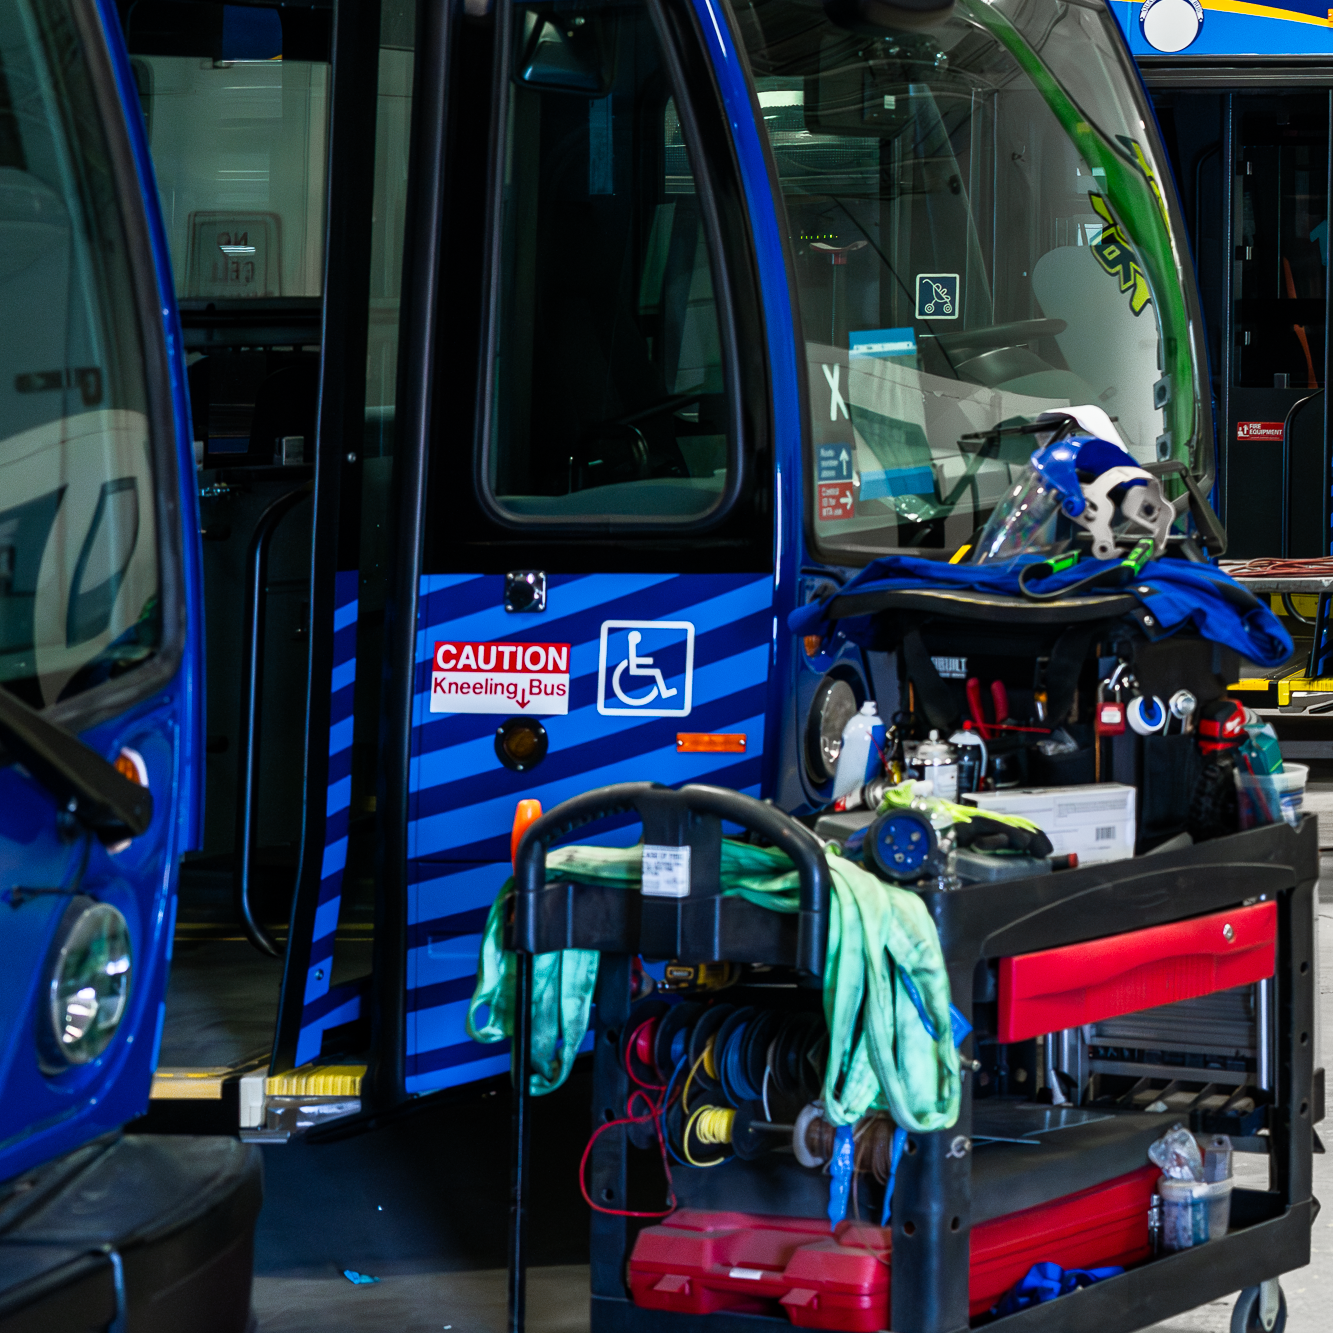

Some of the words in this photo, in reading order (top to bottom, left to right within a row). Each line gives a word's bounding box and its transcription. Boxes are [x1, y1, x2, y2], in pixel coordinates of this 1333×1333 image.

[436, 644, 567, 671] CAUTION
[433, 677, 518, 699] Kneeling
[529, 678, 567, 696] Bus
